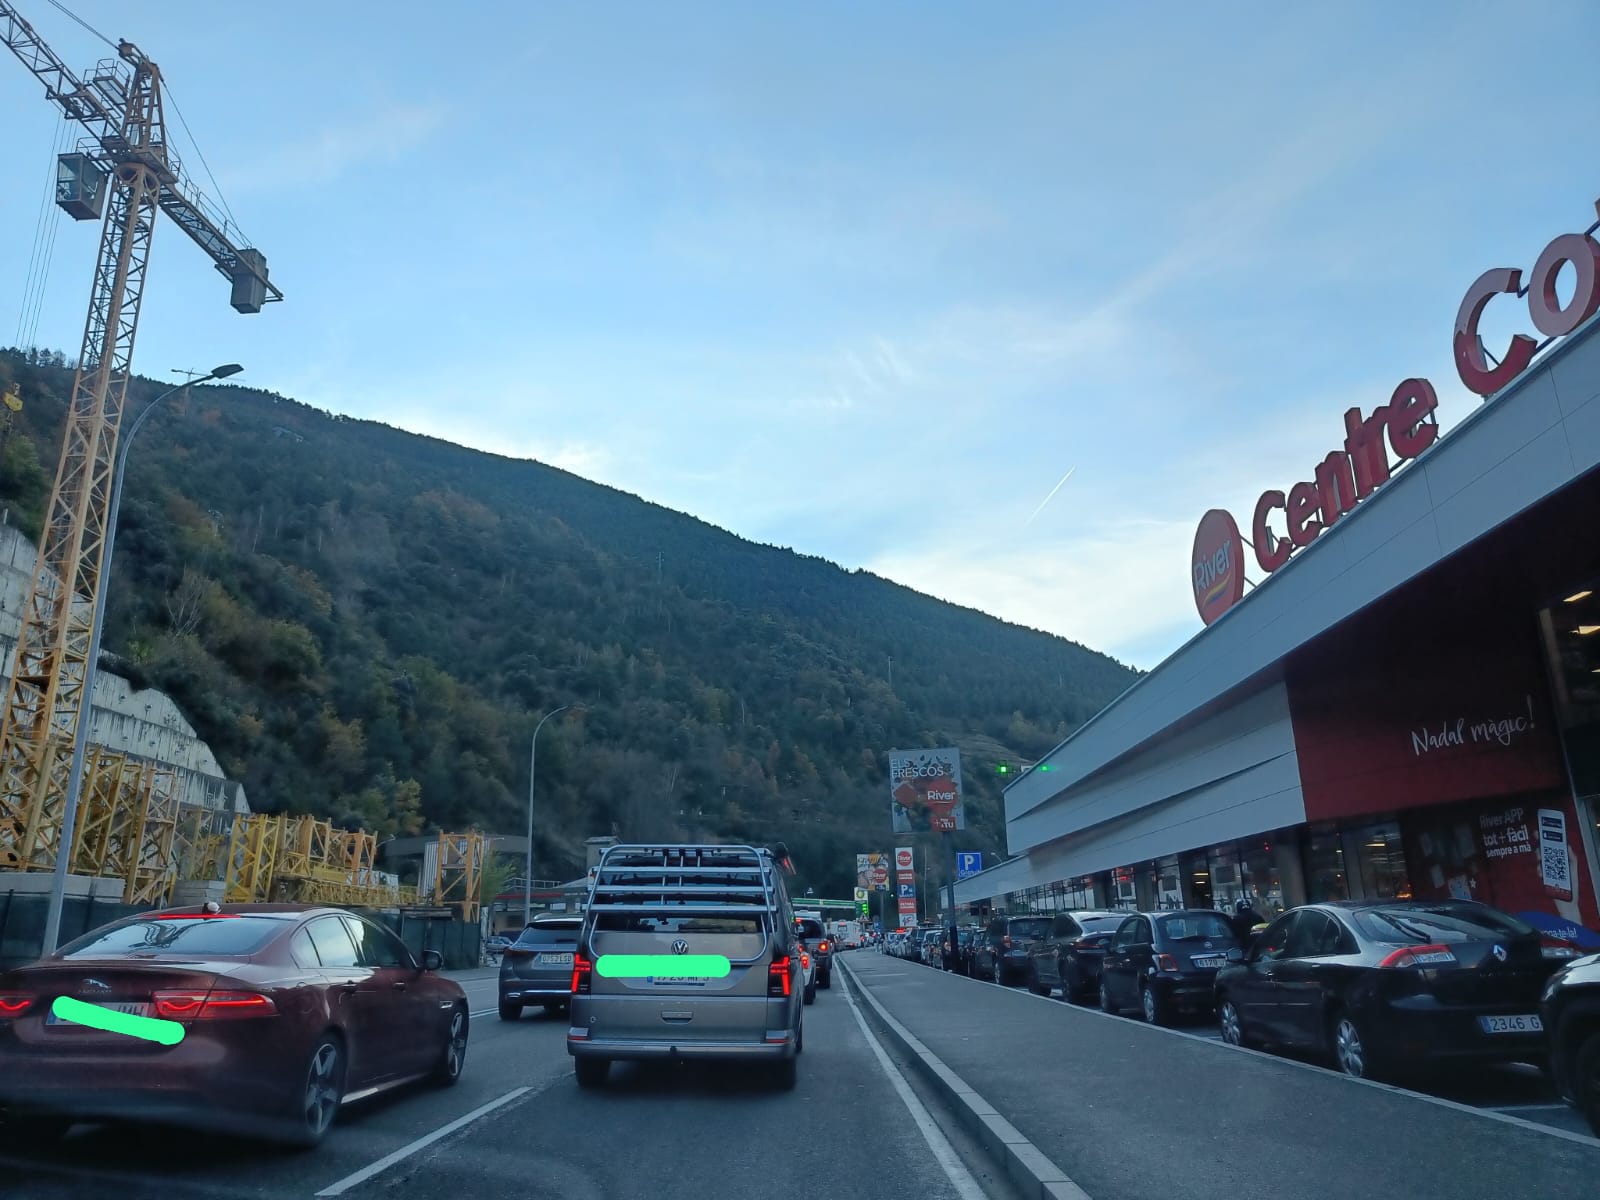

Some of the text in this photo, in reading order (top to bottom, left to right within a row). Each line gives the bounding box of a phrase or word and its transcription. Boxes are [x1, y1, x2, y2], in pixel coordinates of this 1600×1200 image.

[1453, 197, 1600, 396] Co
[1194, 540, 1231, 595] River
[1410, 694, 1535, 757] Nadal màgic!
[891, 766, 944, 778] FRESCOS
[927, 790, 956, 801] River
[1479, 814, 1503, 829] River
[1483, 832, 1498, 847] tot
[1506, 824, 1529, 843] fàcil
[1486, 846, 1513, 859] sempre
[964, 855, 974, 870] P
[901, 885, 908, 895] P
[1490, 1016, 1525, 1031] 2346
